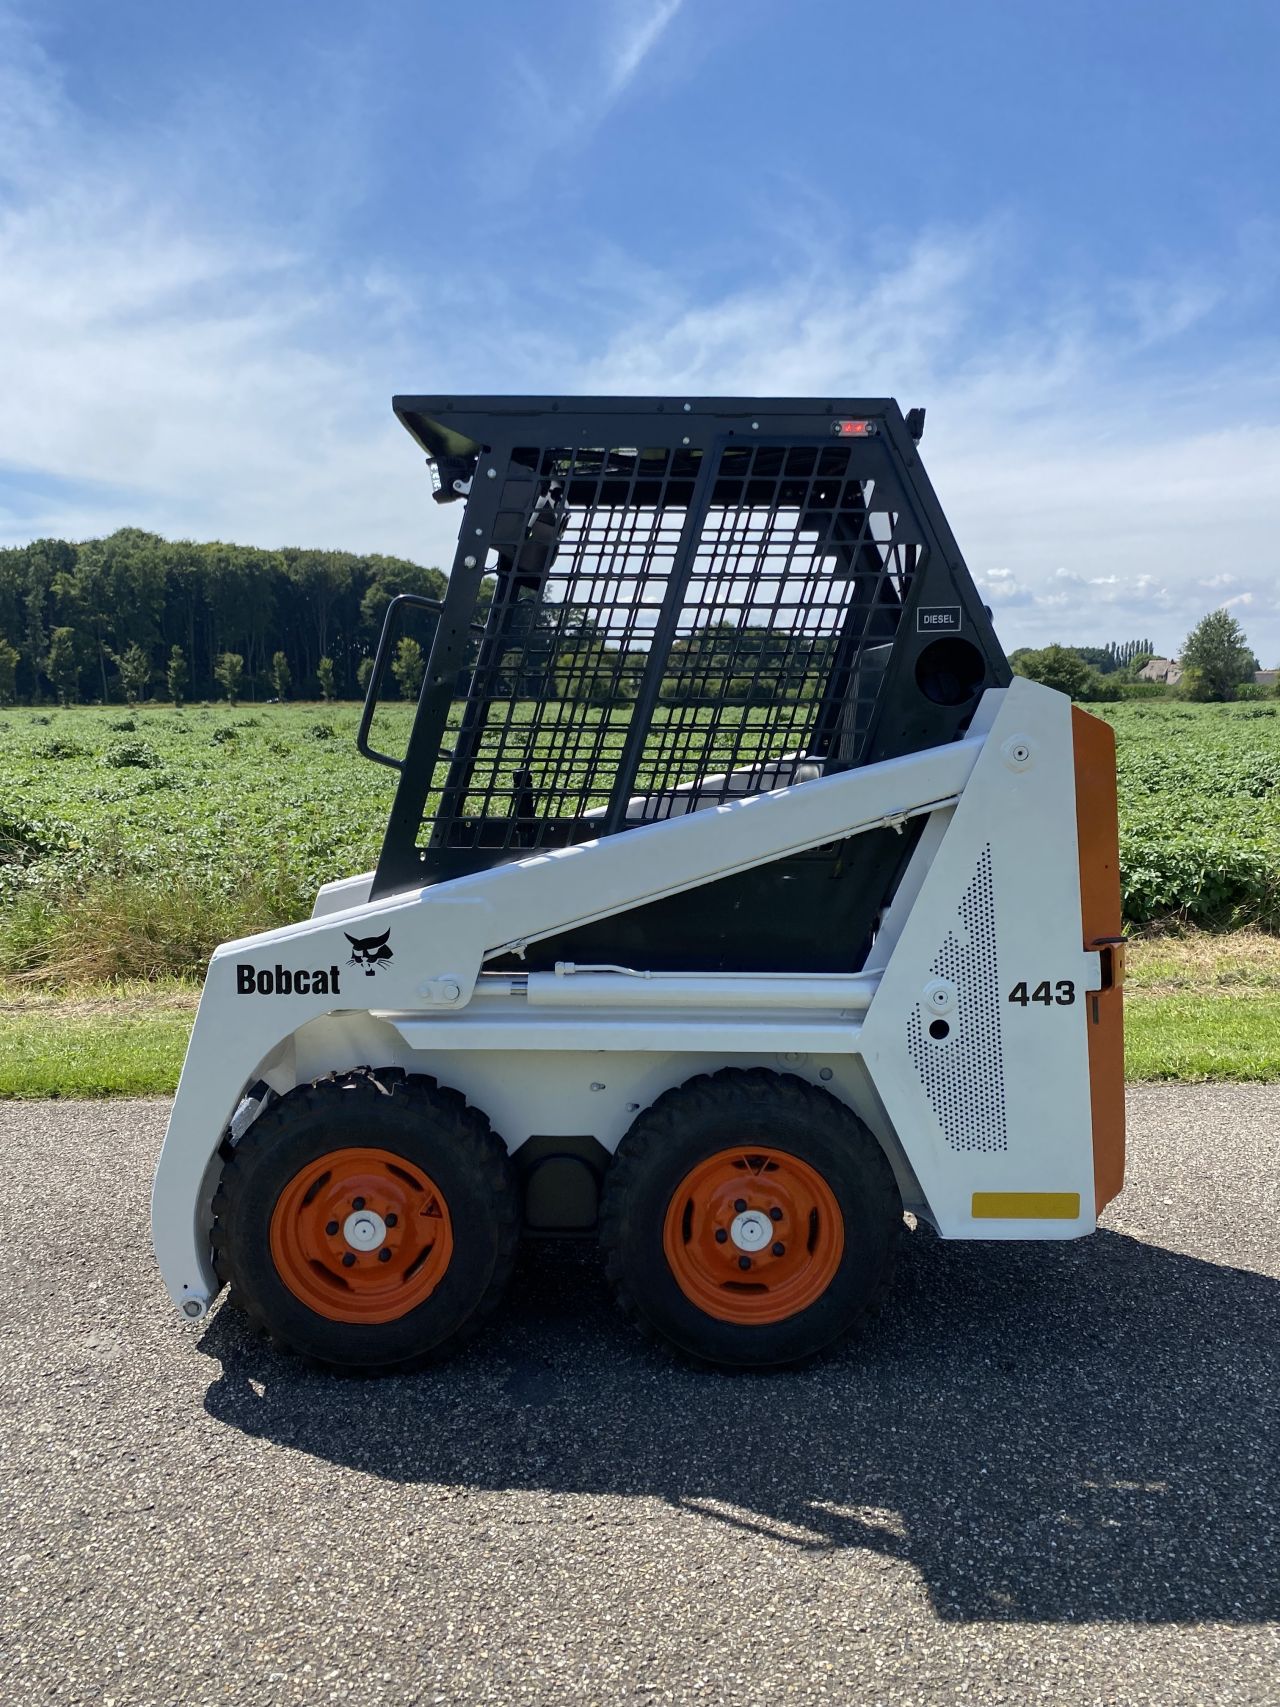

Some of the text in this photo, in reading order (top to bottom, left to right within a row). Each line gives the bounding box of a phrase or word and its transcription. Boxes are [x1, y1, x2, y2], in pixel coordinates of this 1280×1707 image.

[923, 614, 955, 625] DIESEL
[236, 964, 341, 995] Bobcat
[1008, 980, 1076, 1007] 443
